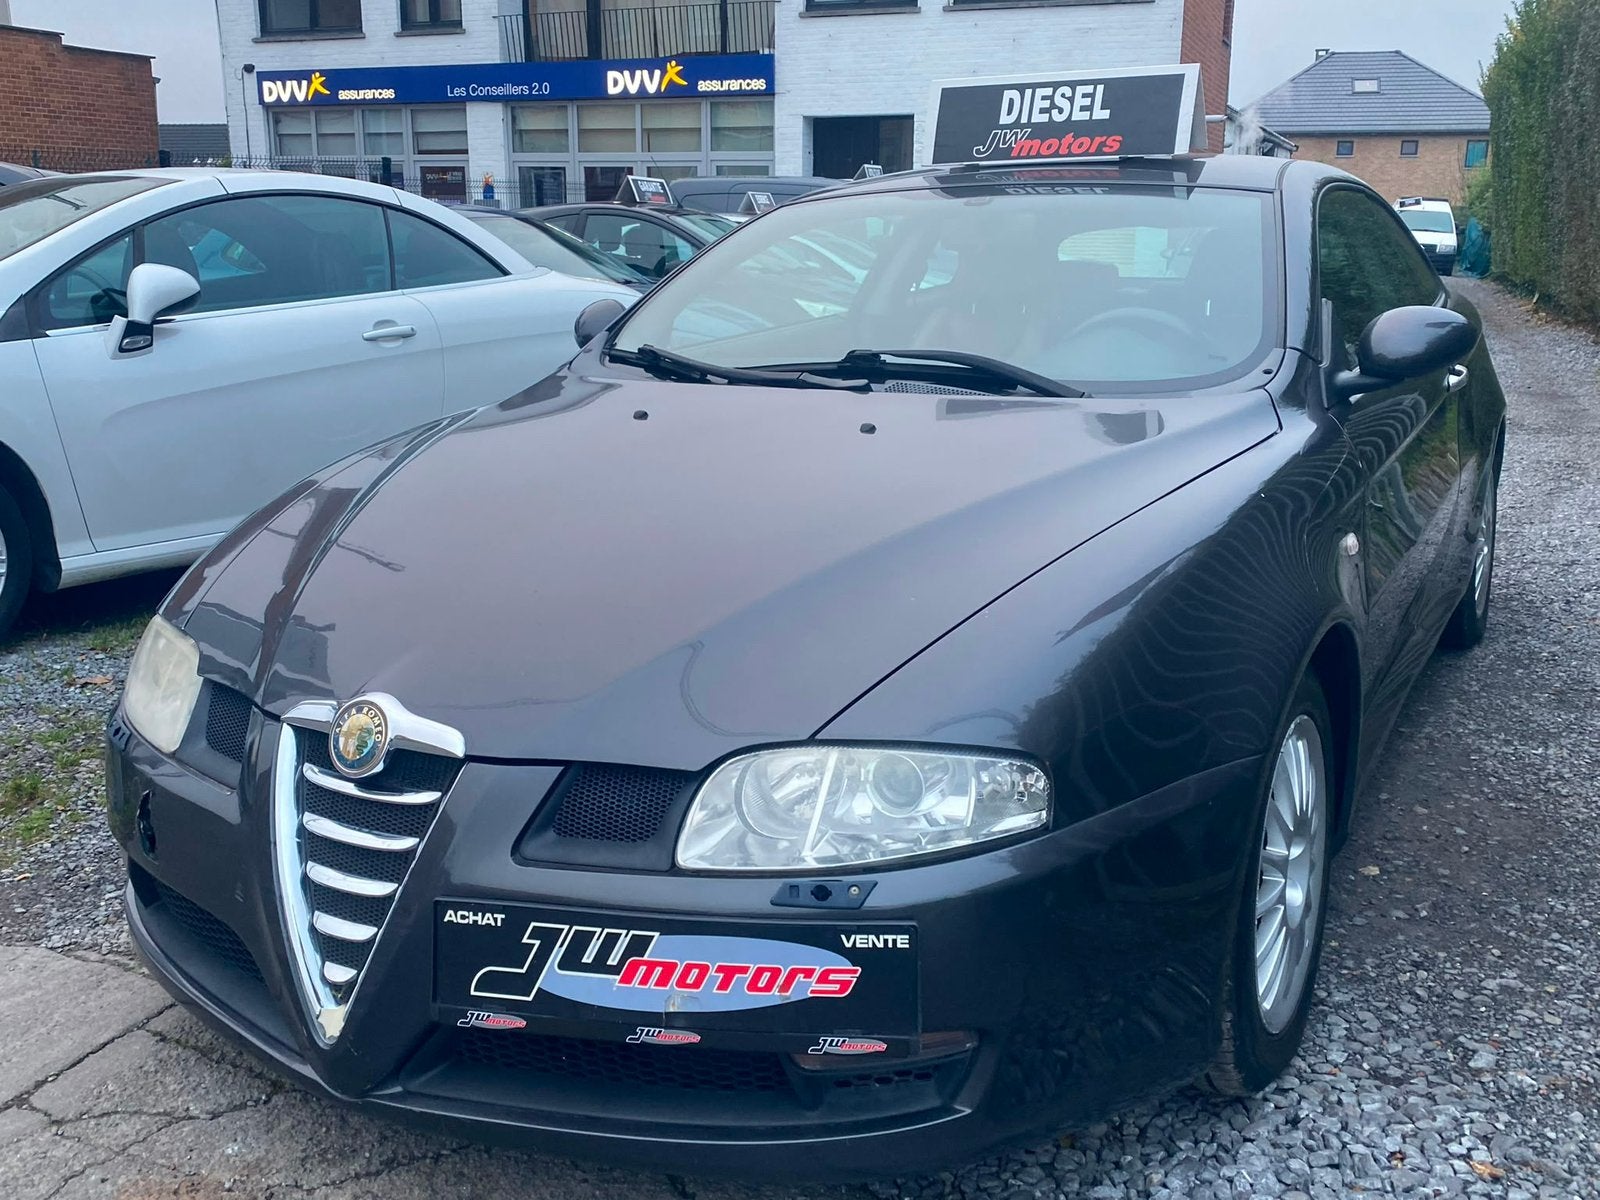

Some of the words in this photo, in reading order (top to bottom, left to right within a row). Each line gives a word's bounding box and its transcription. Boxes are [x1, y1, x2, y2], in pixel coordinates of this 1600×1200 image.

[262, 80, 308, 102] DVV
[447, 85, 466, 96] Les
[469, 83, 529, 96] Conseillers
[532, 82, 550, 95] 2.0
[607, 69, 661, 95] DVV
[697, 79, 766, 91] assurances
[338, 89, 395, 99] assurances
[999, 84, 1111, 124] DIESEL
[973, 128, 1031, 157] JW
[1010, 133, 1123, 157] motors
[361, 706, 383, 742] ROMEO
[443, 909, 506, 927] ACHAT
[840, 933, 910, 949] VENTE
[470, 921, 660, 1001] JW
